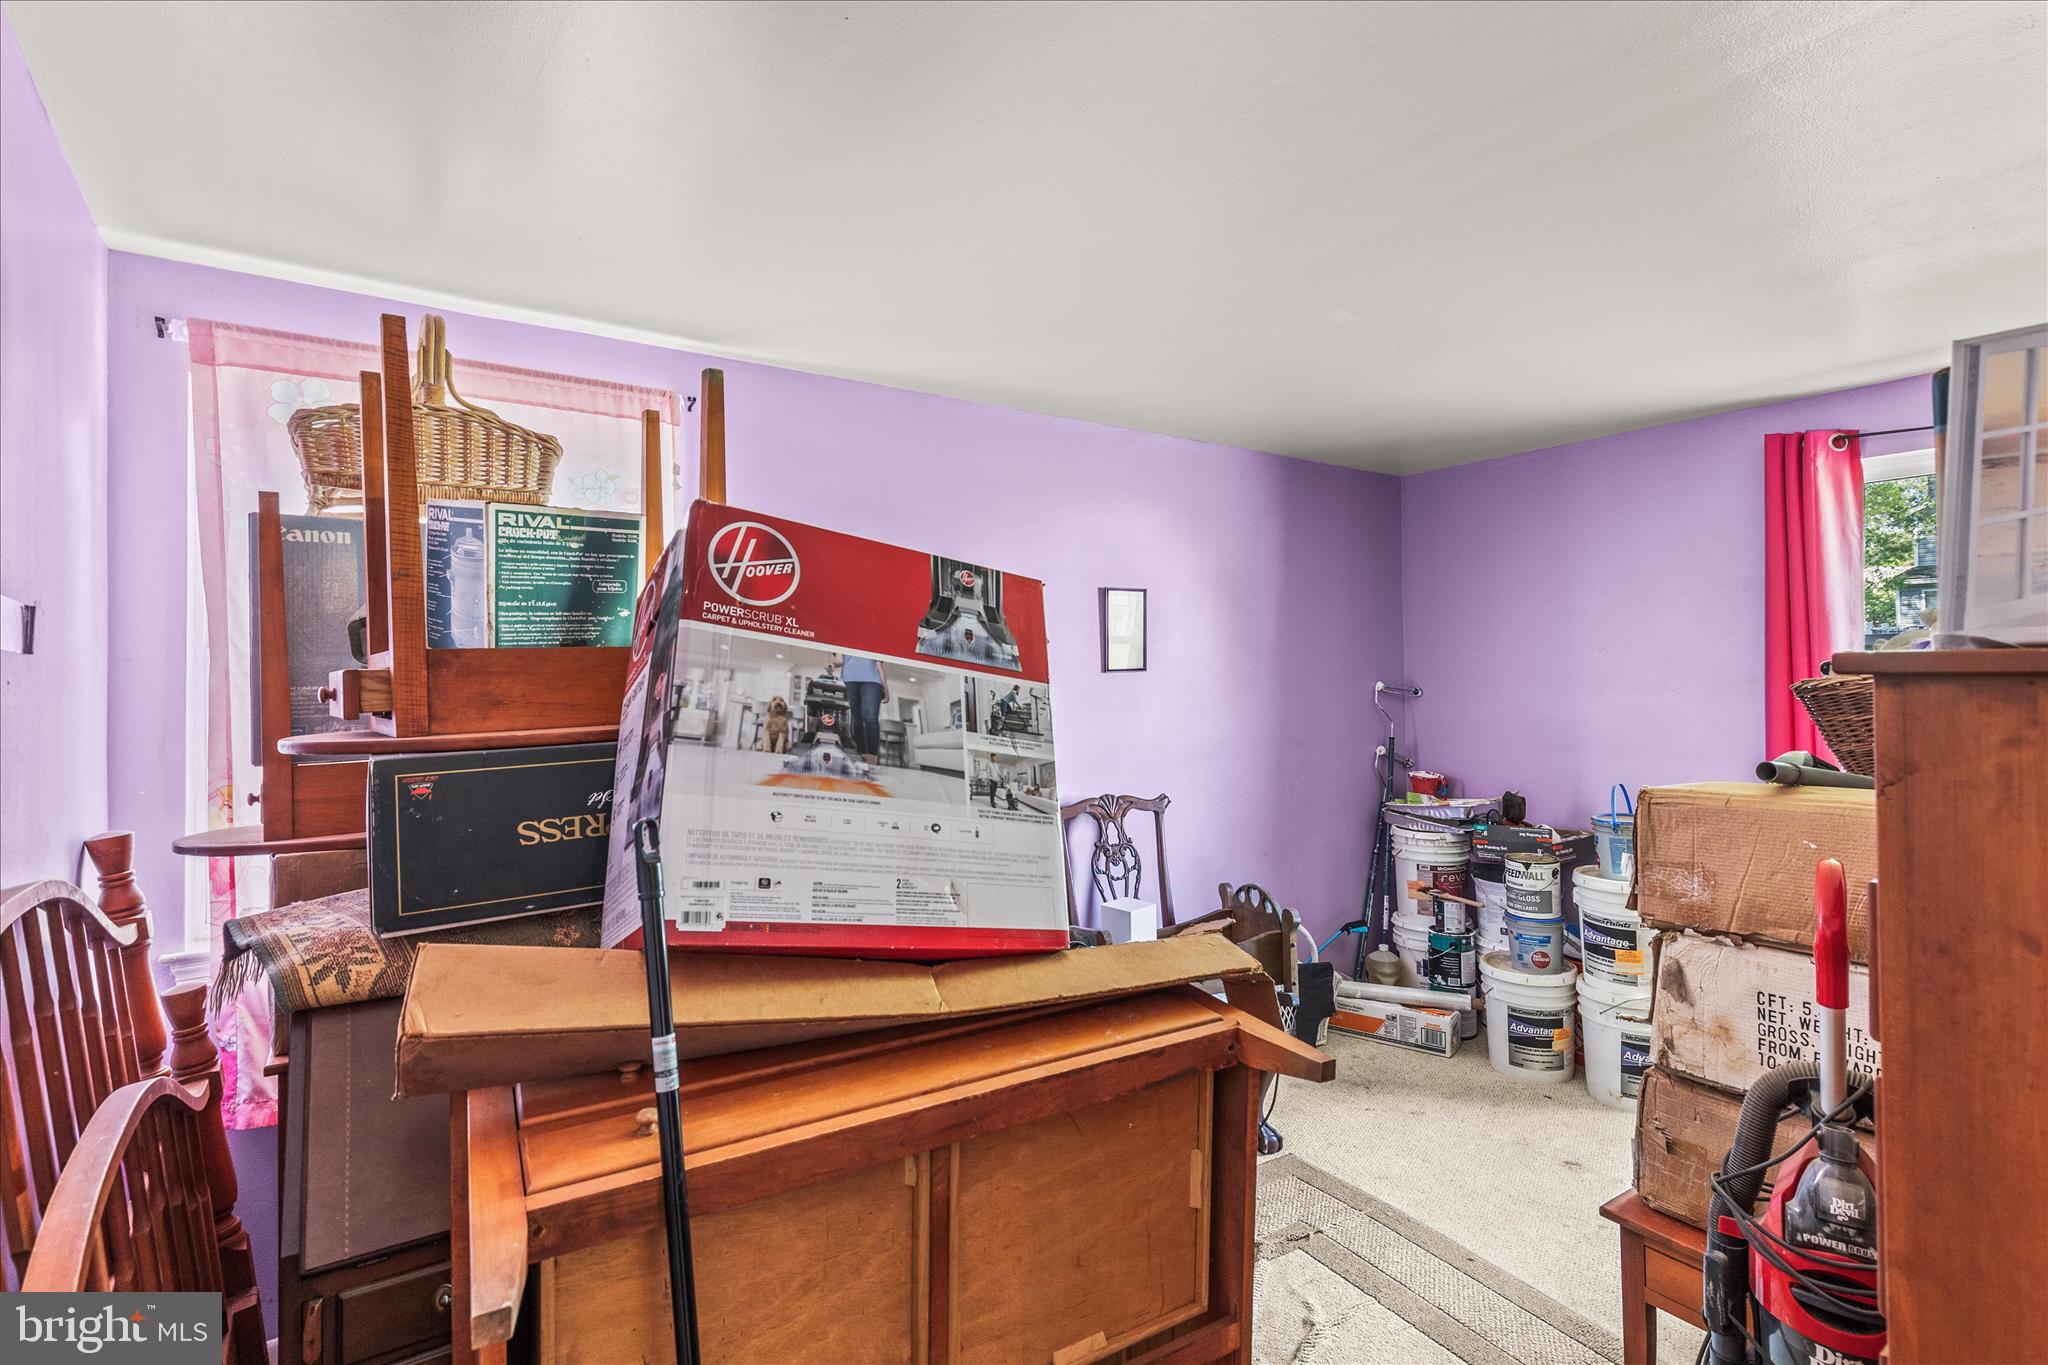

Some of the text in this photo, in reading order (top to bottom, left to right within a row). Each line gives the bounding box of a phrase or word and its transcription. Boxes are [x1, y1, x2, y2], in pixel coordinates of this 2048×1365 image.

[429, 507, 451, 520] RIVAL
[498, 512, 569, 529] RIVAL
[703, 601, 799, 627] POWERSCRUB XL
[702, 612, 730, 623] CARPET
[738, 619, 783, 632] UPHOLSTERY
[784, 627, 815, 638] CLEANER
[517, 813, 610, 846] RESS
[896, 878, 901, 889] 2
[1604, 917, 1631, 928] Paints
[1584, 929, 1630, 947] Advantage
[1757, 991, 1820, 1017] CFT: 5.
[1758, 1006, 1791, 1027] NET.
[1510, 1022, 1554, 1036] Advantag
[1758, 1023, 1815, 1047] GROSS.
[1623, 1051, 1650, 1063] Adva
[1758, 1037, 1806, 1061] FROM:
[1829, 1204, 1860, 1220] Devil
[1832, 1196, 1854, 1210] Dirt
[1802, 1232, 1878, 1260] POWER BRUS
